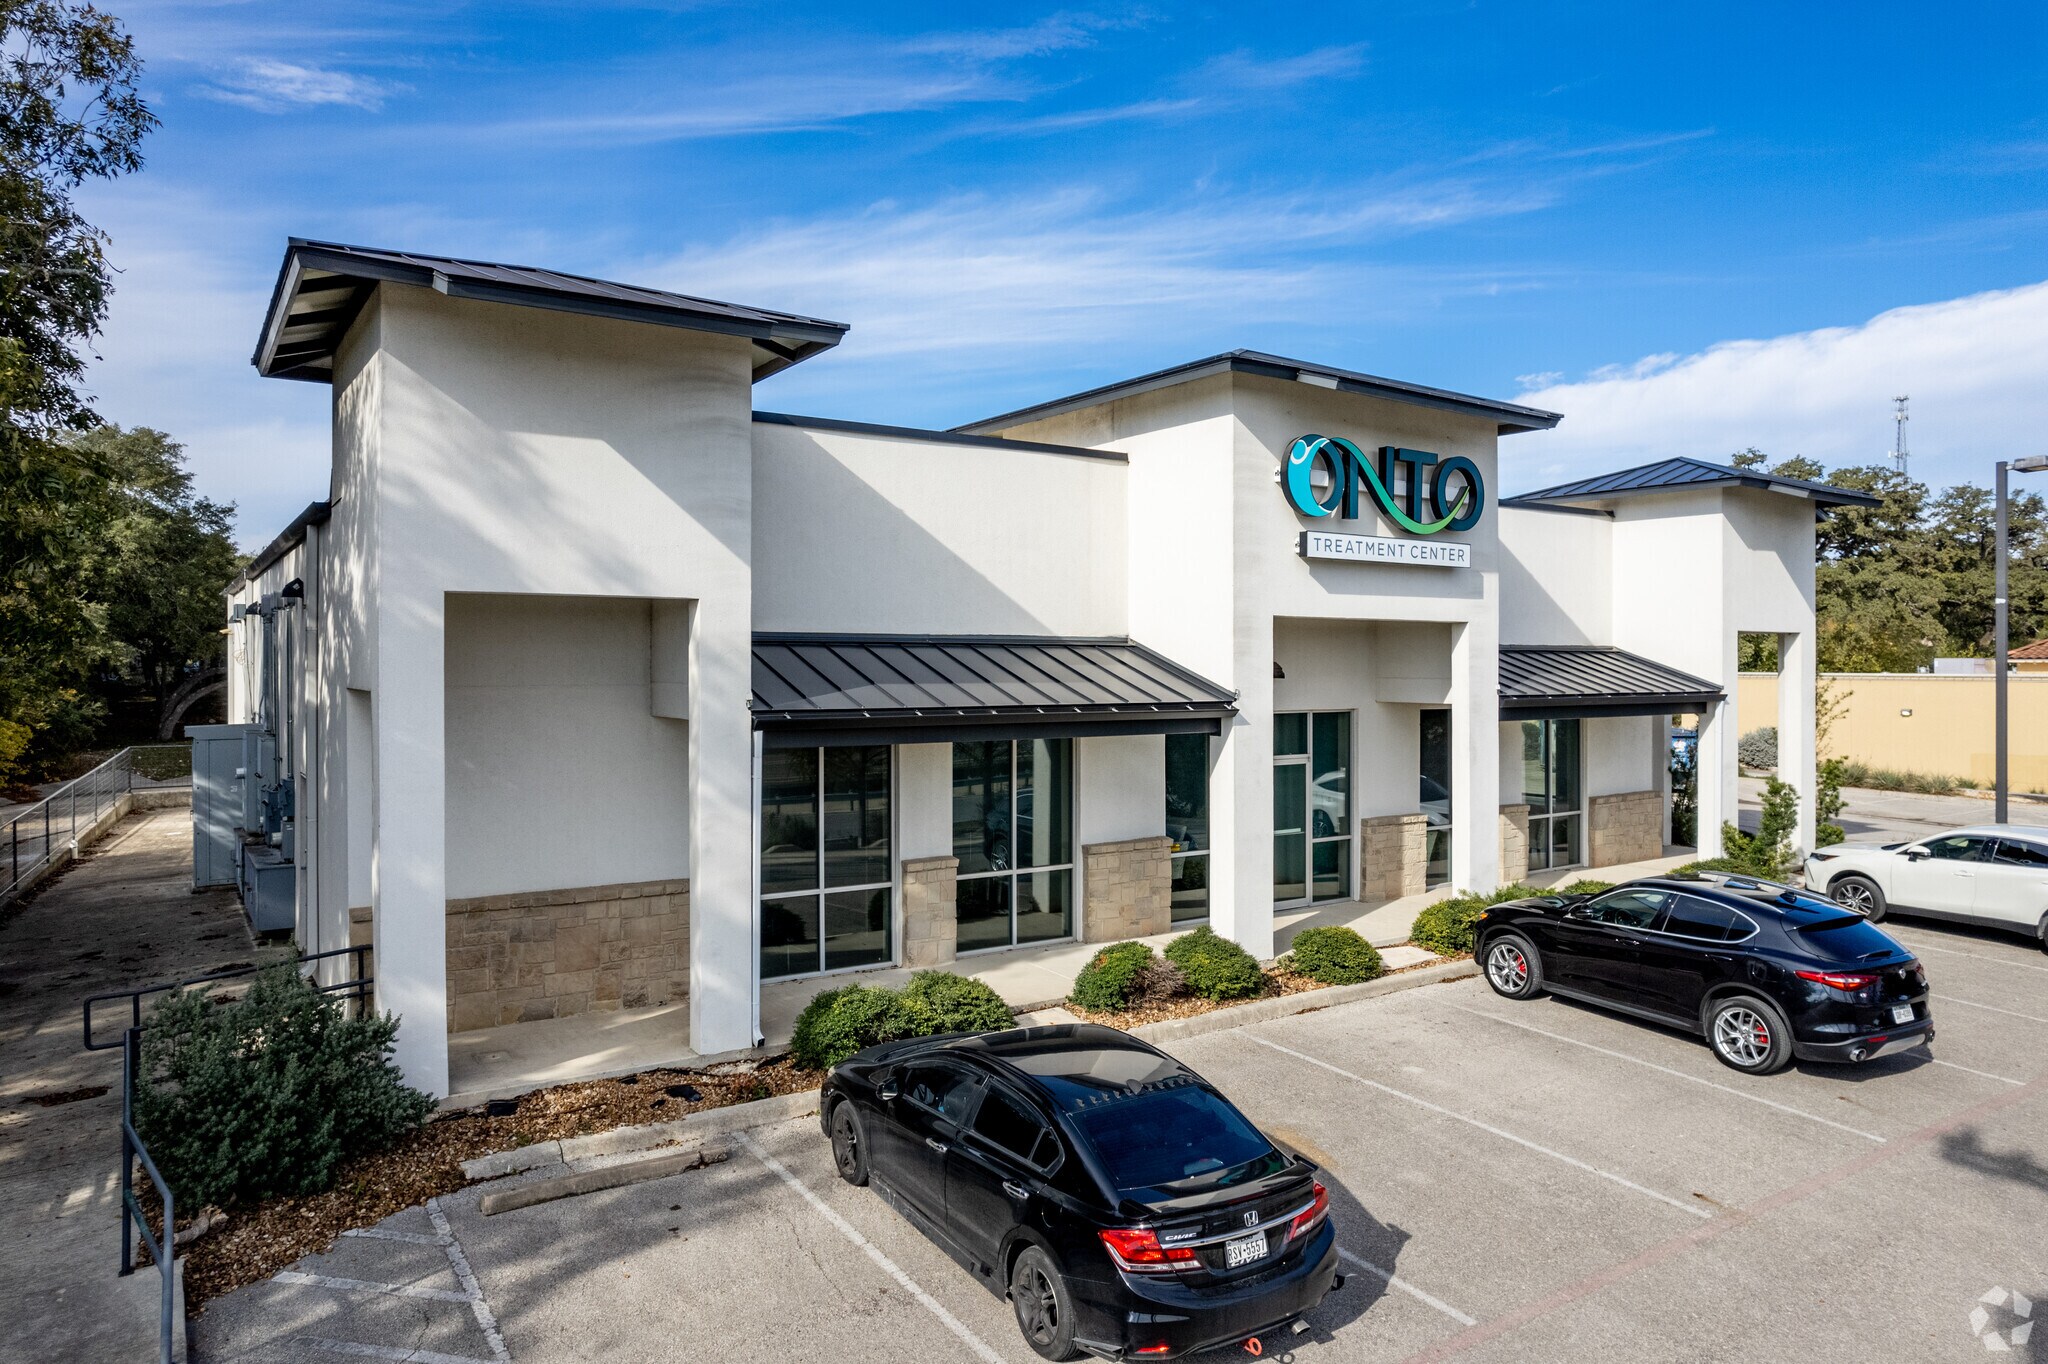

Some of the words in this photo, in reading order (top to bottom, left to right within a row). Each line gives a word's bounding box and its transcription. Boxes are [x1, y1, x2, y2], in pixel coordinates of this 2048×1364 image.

[1280, 433, 1484, 535] ONTO
[1313, 537, 1405, 558] TREATMENT
[1410, 545, 1466, 562] CENTER
[1165, 1232, 1197, 1241] CIVIC
